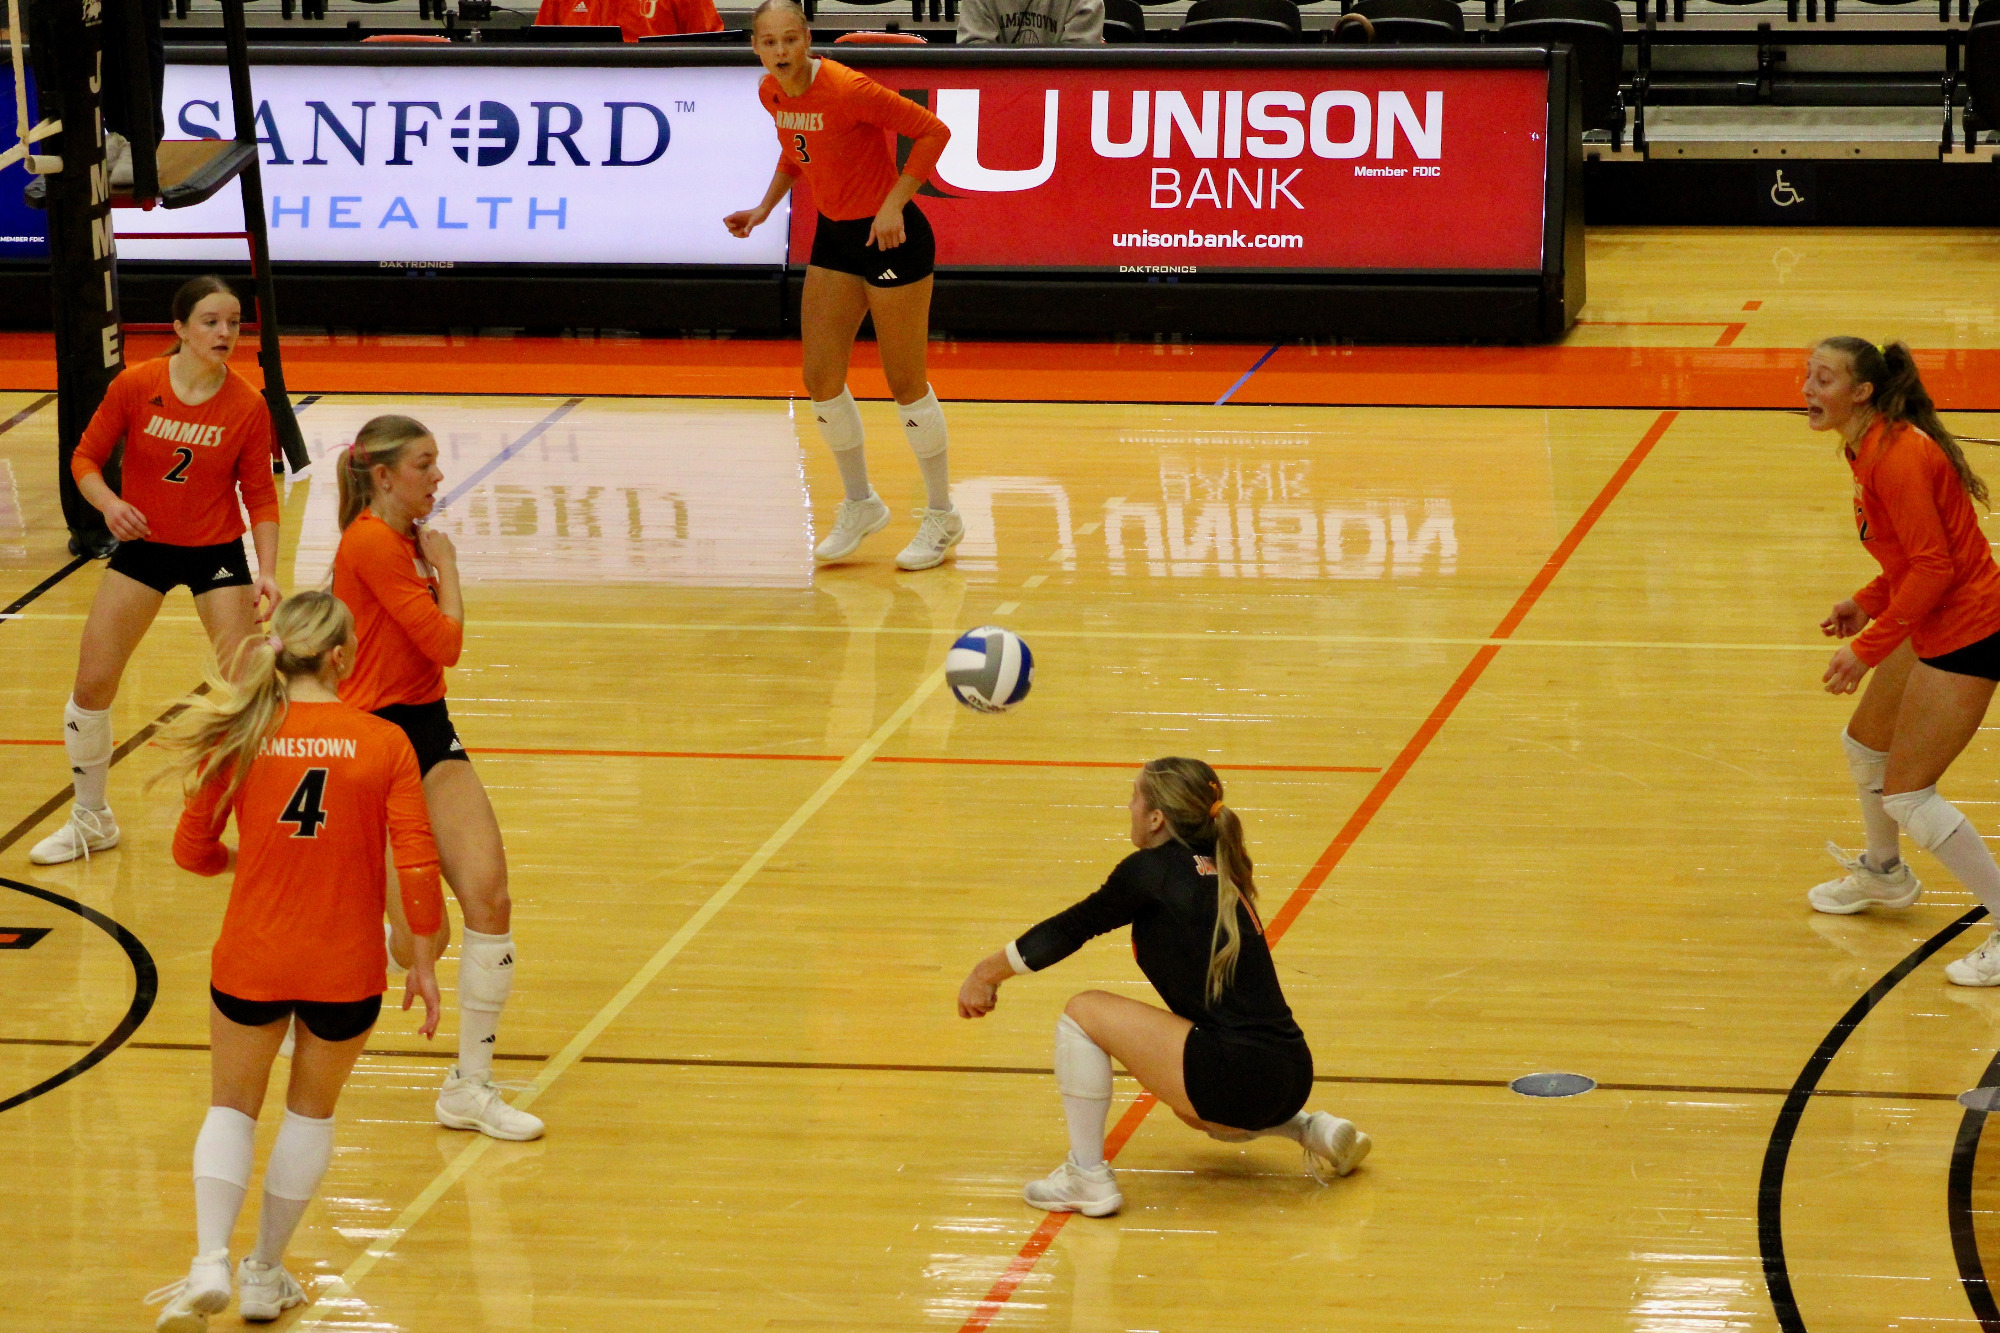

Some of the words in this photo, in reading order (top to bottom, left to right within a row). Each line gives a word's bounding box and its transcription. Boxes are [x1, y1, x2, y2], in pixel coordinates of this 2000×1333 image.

[178, 99, 671, 167] SANFORD
[1091, 90, 1444, 159] UNISON
[793, 133, 811, 164] 3
[1354, 166, 1408, 177] Member
[1412, 166, 1441, 177] FDIC
[1150, 168, 1305, 209] BANK
[271, 196, 567, 229] HEALTH
[1112, 229, 1304, 248] unisonbank.com
[379, 261, 455, 269] DAKTRONICS
[1119, 265, 1197, 273] DAKTRONICS
[143, 414, 226, 447] JIMMIES
[162, 446, 194, 484] 2
[254, 737, 357, 759] AMESTOWN
[277, 767, 329, 838] 4
